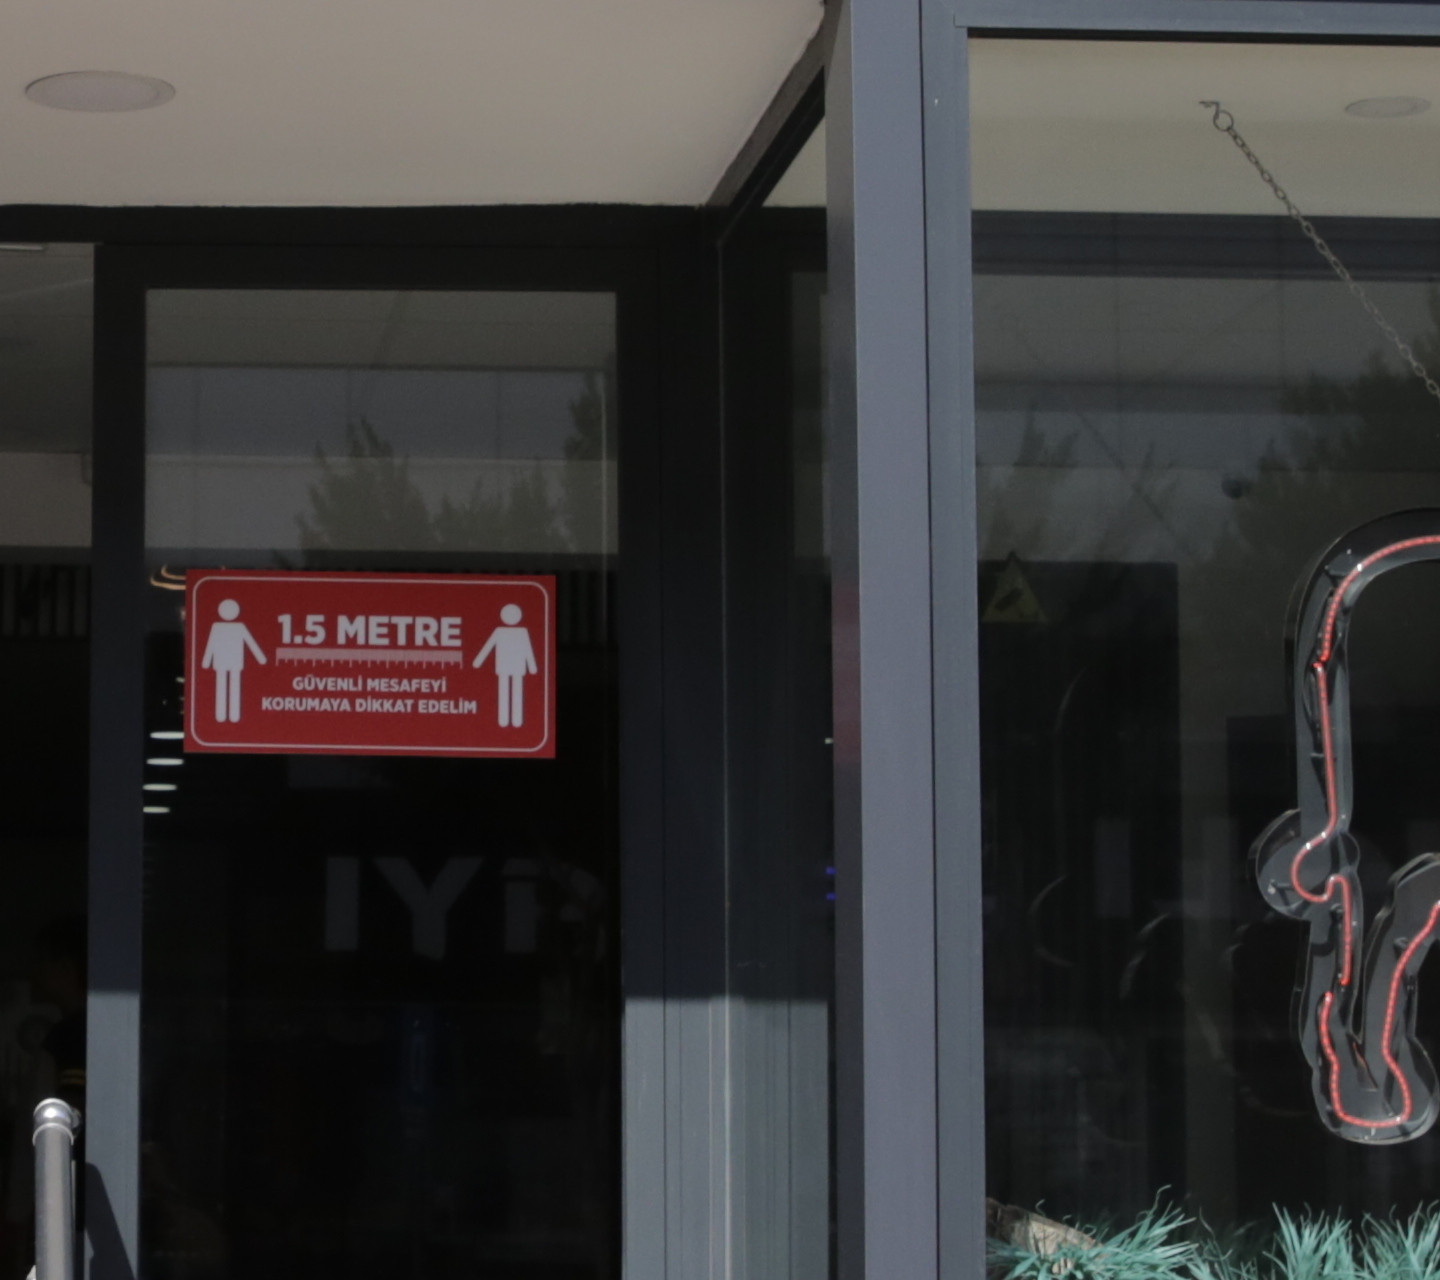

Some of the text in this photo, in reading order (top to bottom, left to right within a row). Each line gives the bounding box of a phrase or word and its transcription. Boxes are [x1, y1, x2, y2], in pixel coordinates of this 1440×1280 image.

[277, 613, 462, 647] 1.5 METRE
[291, 672, 447, 693] GÜVENLİ MESAFEYİ
[261, 694, 477, 715] KORUMAYA DİKKAT EDELİM
